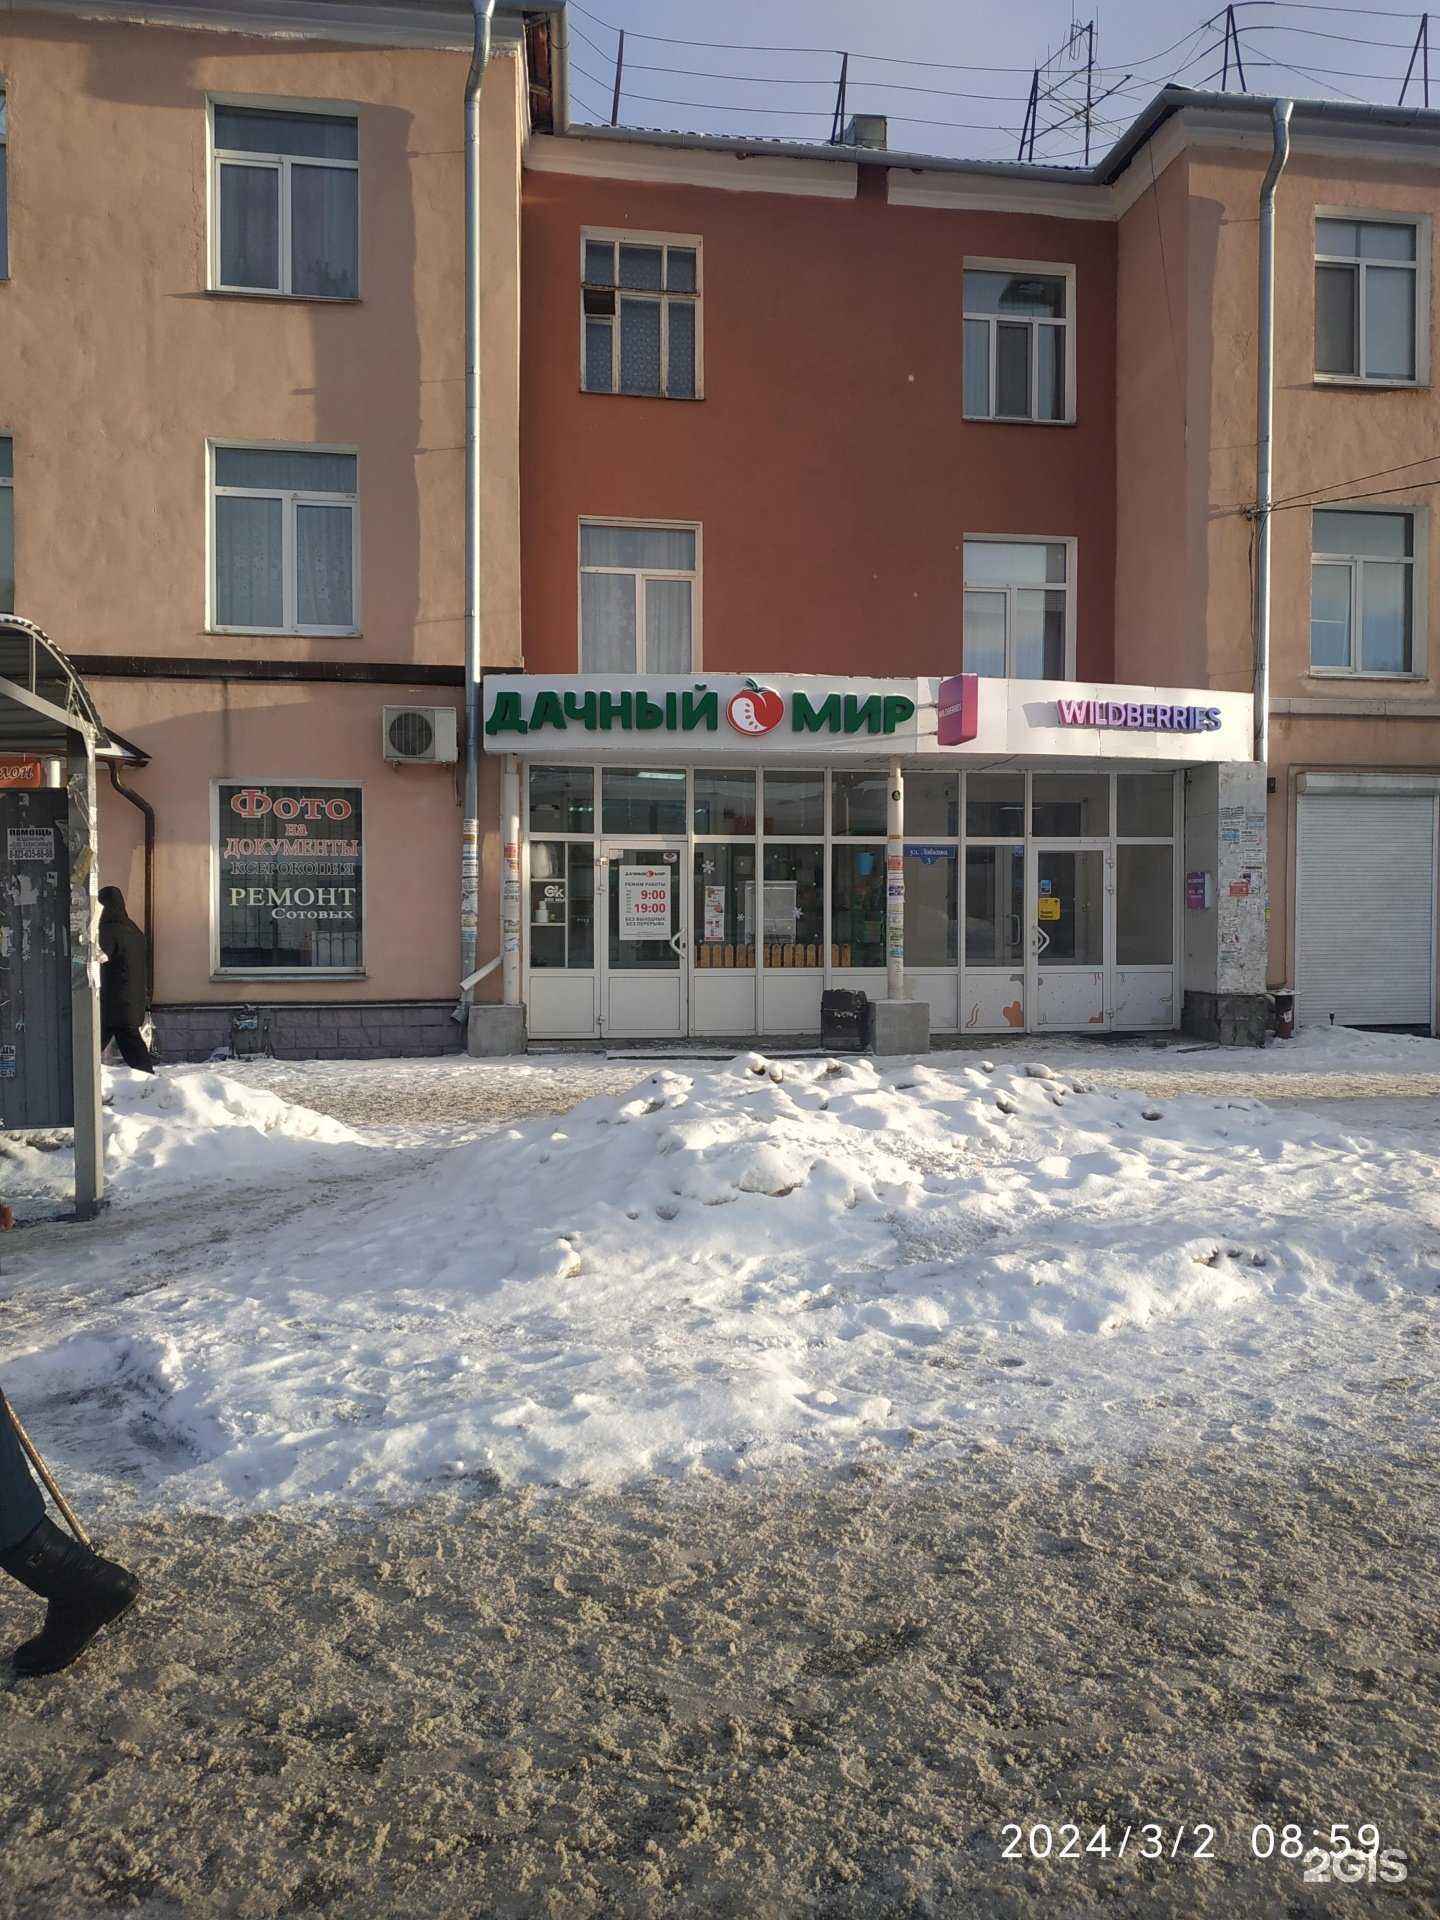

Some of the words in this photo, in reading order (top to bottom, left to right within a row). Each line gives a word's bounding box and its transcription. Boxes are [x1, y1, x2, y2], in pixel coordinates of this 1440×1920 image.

[485, 684, 719, 735] ДАЧНЫЙ
[791, 692, 916, 733] МИР
[1058, 699, 1222, 733] WILDBERRIES
[231, 789, 352, 820] Фото
[285, 823, 308, 836] на
[223, 838, 359, 859] ДОКУМЕНТЫ
[230, 861, 355, 876] КСЕРОКОПИЯ
[229, 887, 357, 906] РЕМОНТ
[640, 889, 666, 900] 9:00
[634, 903, 666, 913] 19:00
